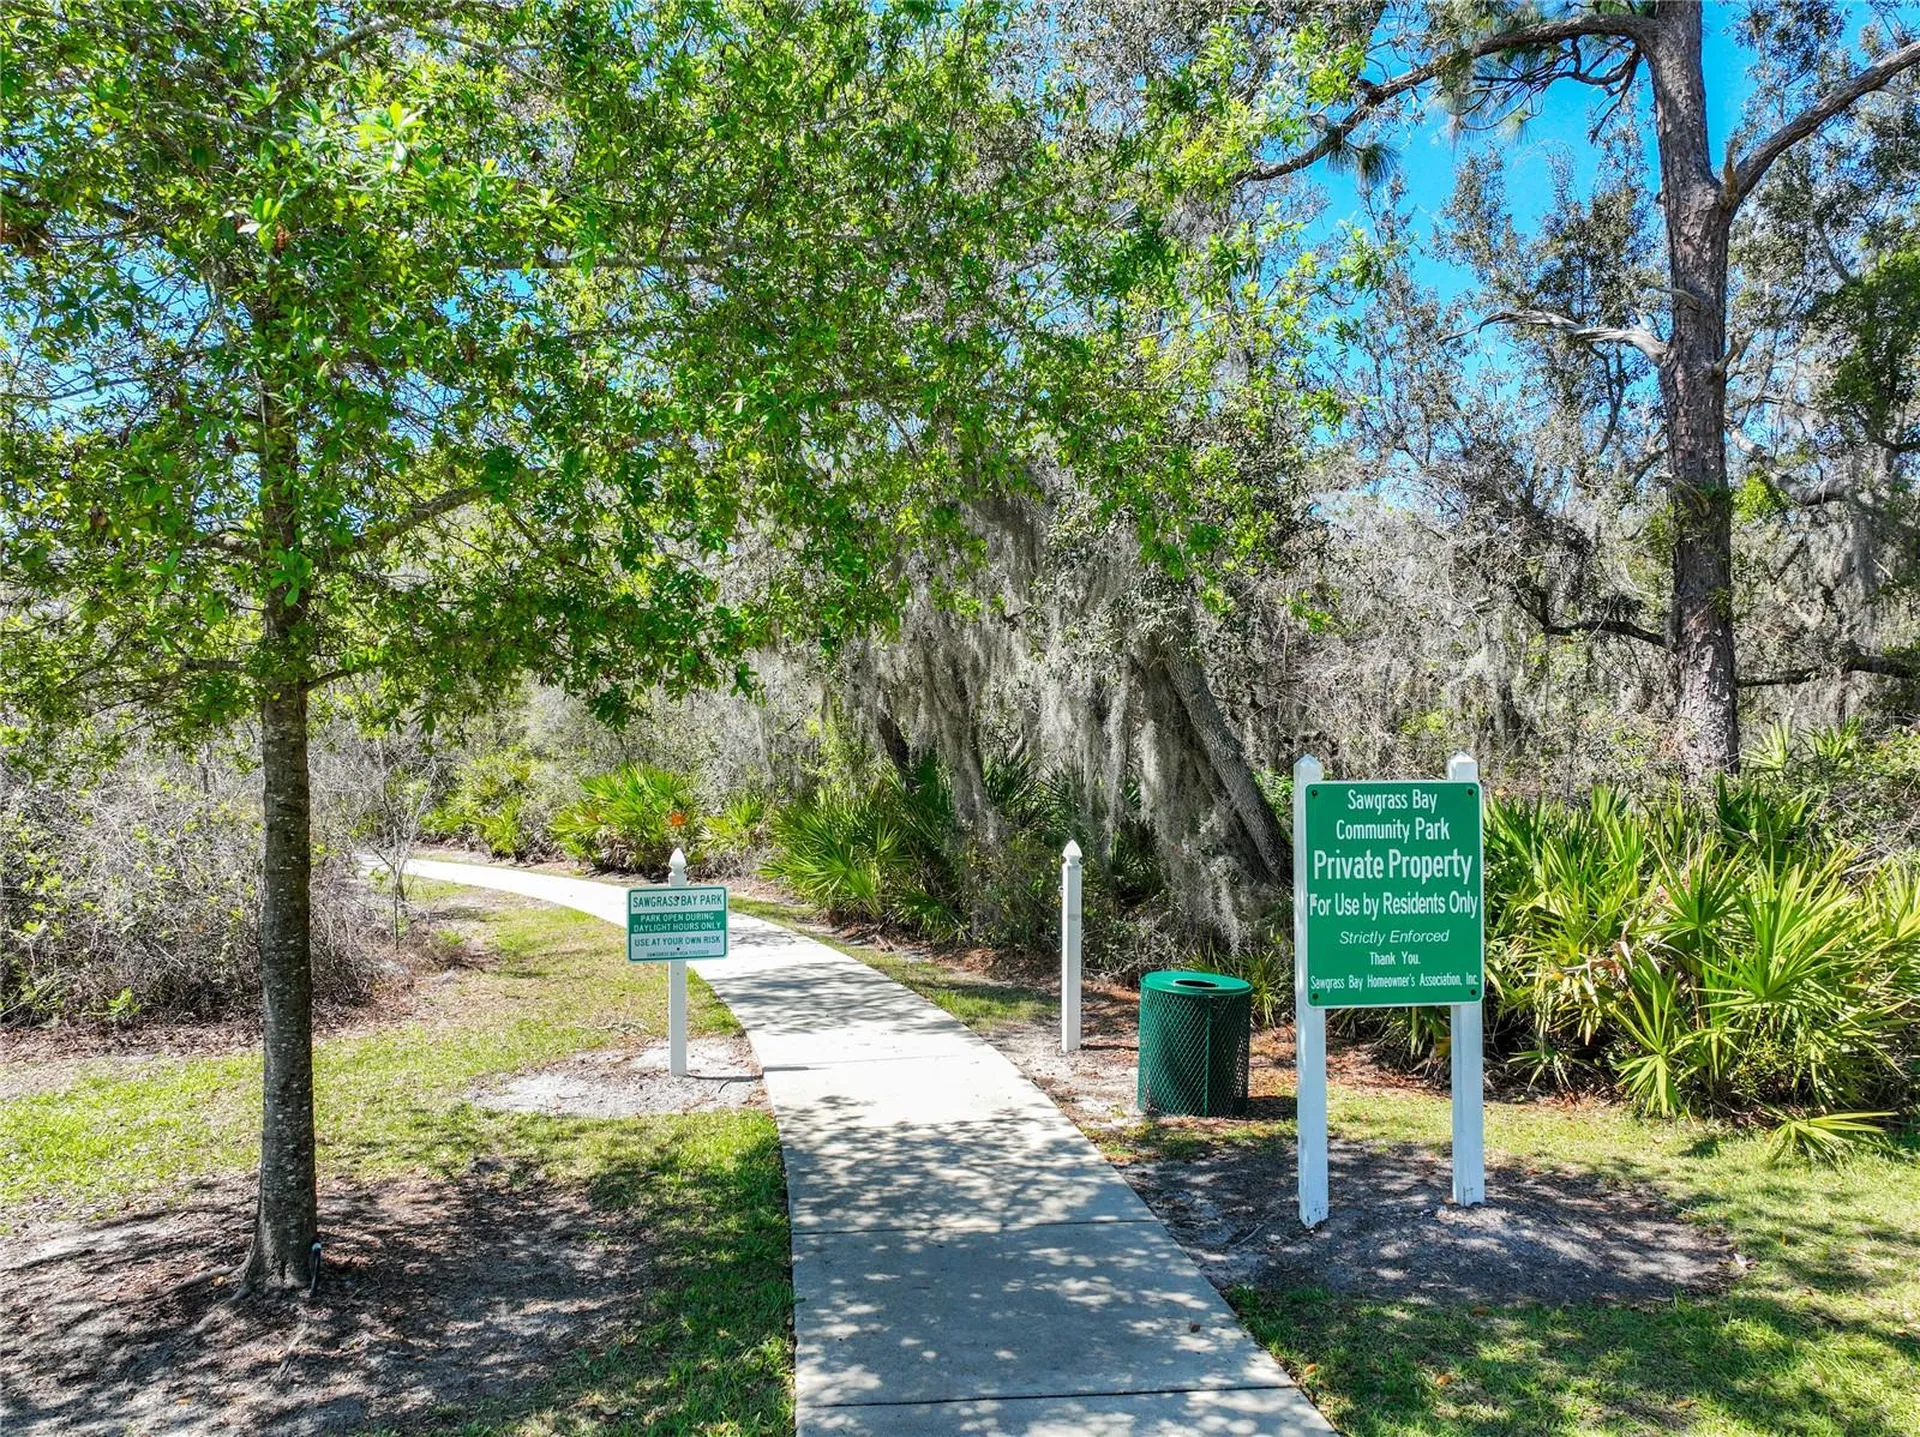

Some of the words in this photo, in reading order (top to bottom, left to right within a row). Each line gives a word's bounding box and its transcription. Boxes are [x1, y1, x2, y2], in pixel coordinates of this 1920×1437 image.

[1348, 789, 1408, 815] Sawgrass
[1413, 789, 1437, 813] Bay
[1336, 819, 1409, 843] Community
[1415, 817, 1450, 840] Park
[1314, 849, 1384, 879] Private
[1389, 848, 1472, 884] Property
[633, 896, 679, 908] SAWGRASS
[682, 895, 697, 906] BAY
[700, 894, 722, 904] PARK
[1309, 893, 1331, 916] For
[1335, 892, 1360, 916] Use
[1364, 892, 1379, 920] by
[1383, 892, 1445, 915] Residents
[1450, 891, 1478, 919] Only
[634, 924, 671, 932] DAYLIGHT
[635, 938, 649, 946] USE
[651, 938, 660, 946] AT
[663, 937, 683, 945] YOUR
[1340, 931, 1385, 946] Strictly
[1390, 929, 1449, 943] Enforced
[1370, 952, 1395, 965] Thank
[1402, 951, 1421, 964] You.
[1311, 976, 1344, 992] Sawgrass
[1349, 975, 1363, 992] Bay
[1367, 974, 1415, 988] Homeowner's
[1466, 972, 1479, 985] Inc.
